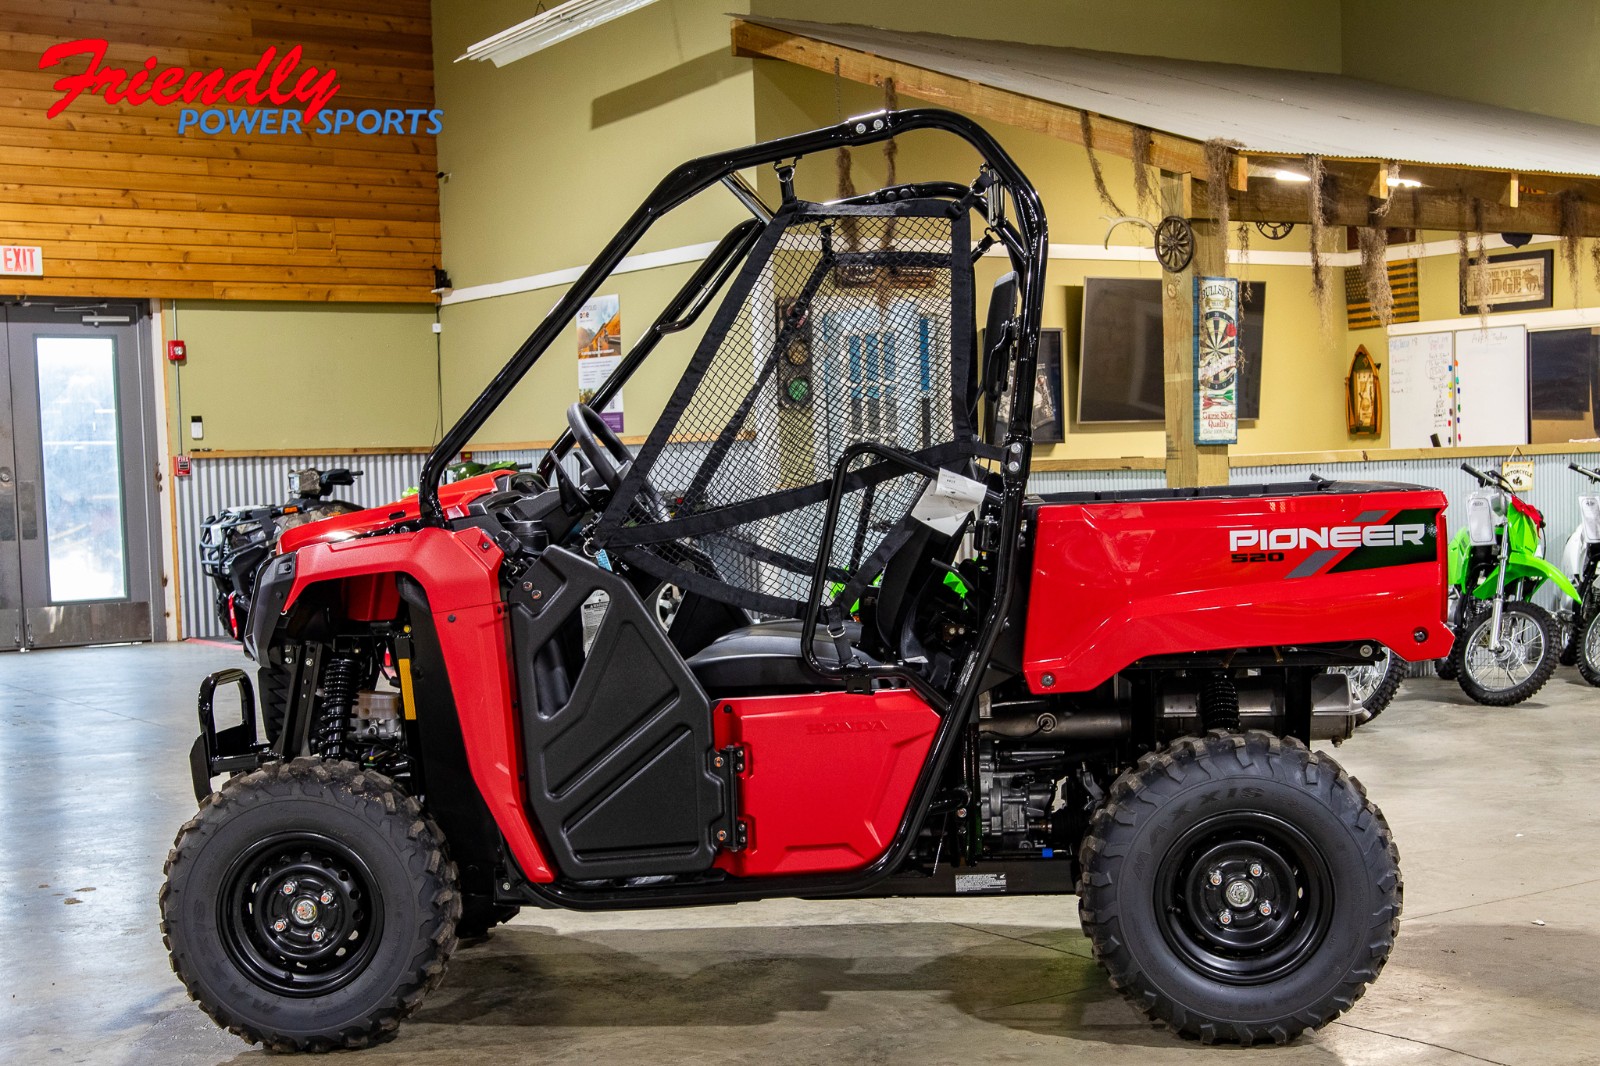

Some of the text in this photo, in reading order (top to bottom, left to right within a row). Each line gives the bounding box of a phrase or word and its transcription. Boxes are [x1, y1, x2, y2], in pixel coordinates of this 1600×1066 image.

[3, 247, 35, 272] EXIT
[1207, 419, 1229, 429] Quality
[1502, 469, 1533, 478] MOTORCYCLE
[1229, 522, 1425, 552] PIONEER
[1231, 552, 1284, 563] 520
[806, 719, 889, 735] HONDA
